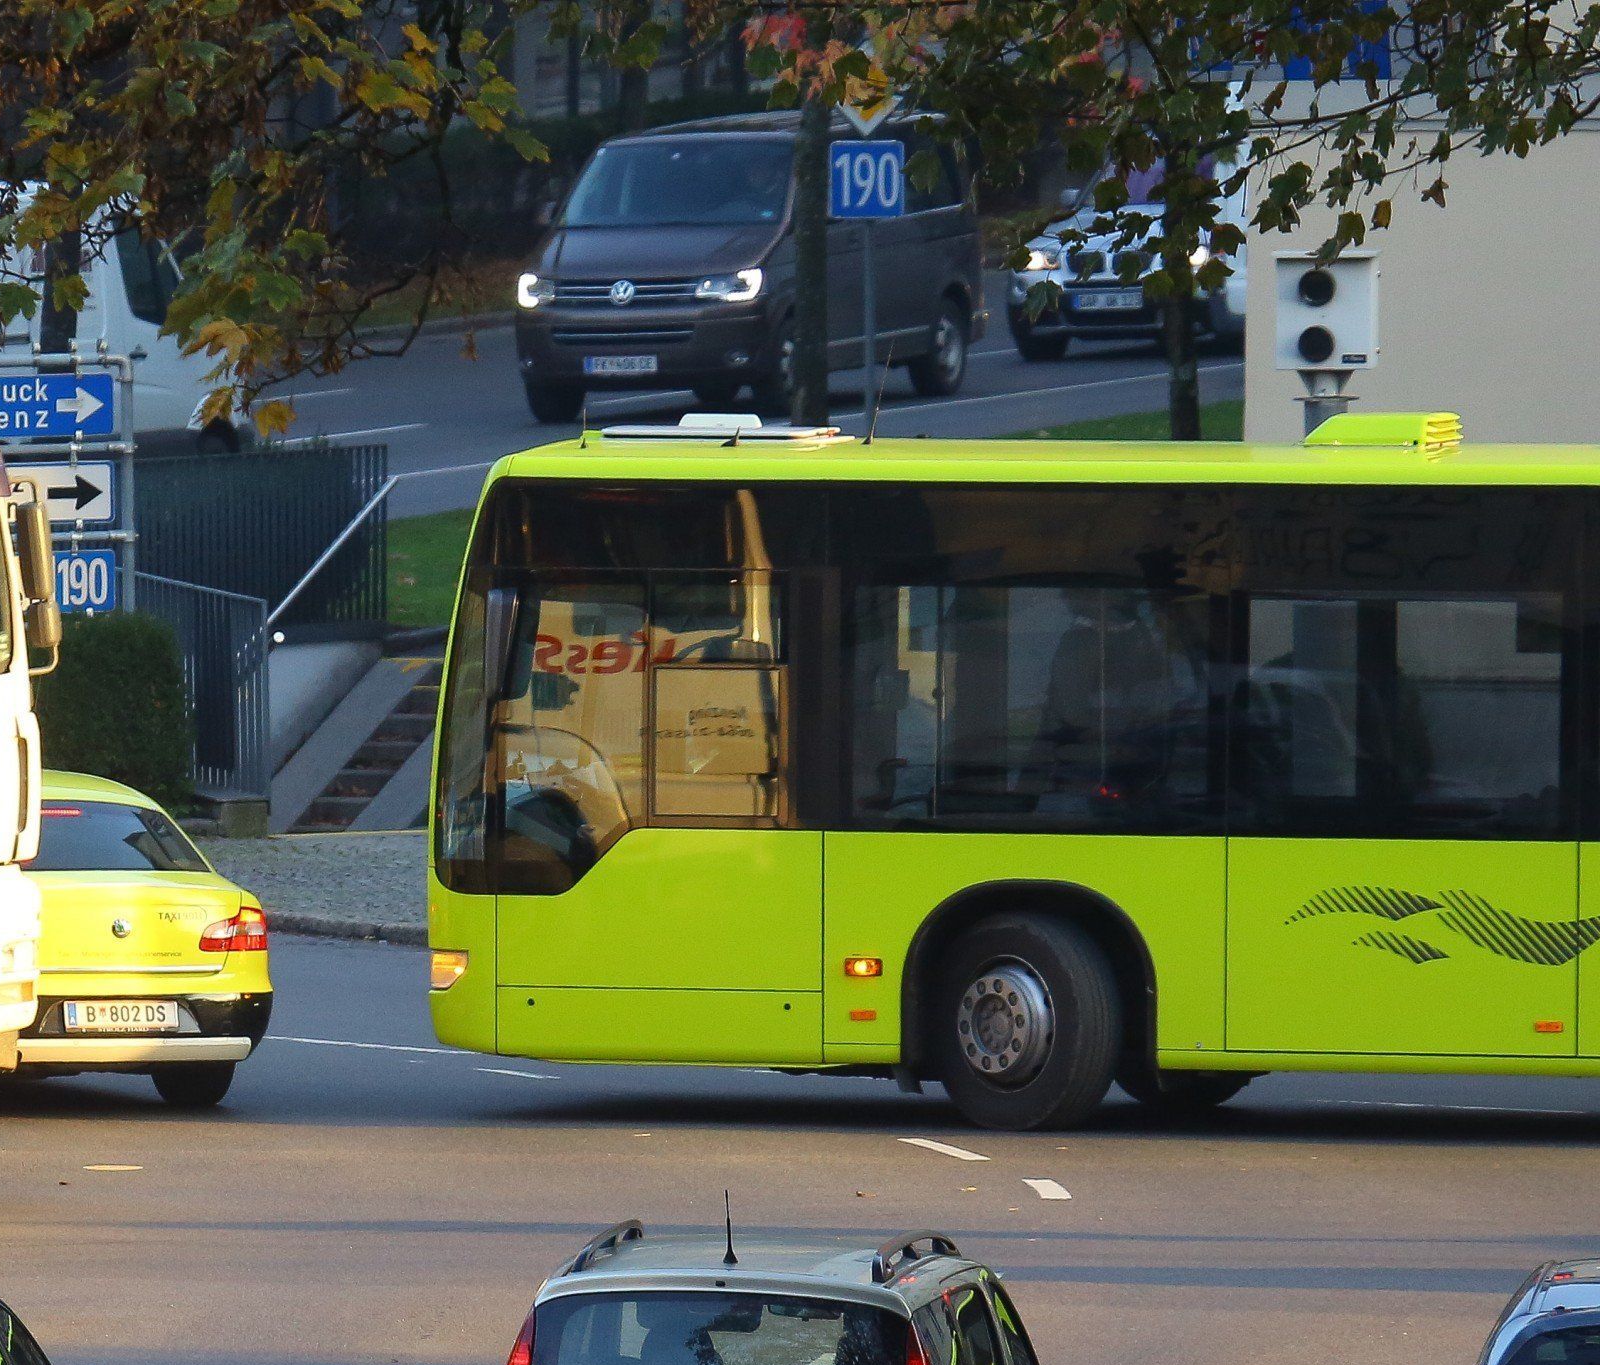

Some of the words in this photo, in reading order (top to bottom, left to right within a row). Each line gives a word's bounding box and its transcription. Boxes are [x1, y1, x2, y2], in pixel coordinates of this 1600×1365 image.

[835, 153, 899, 207] 190
[57, 558, 108, 606] 190
[87, 1006, 96, 1022] B
[110, 1005, 142, 1023] 802
[146, 1005, 166, 1022] DS
